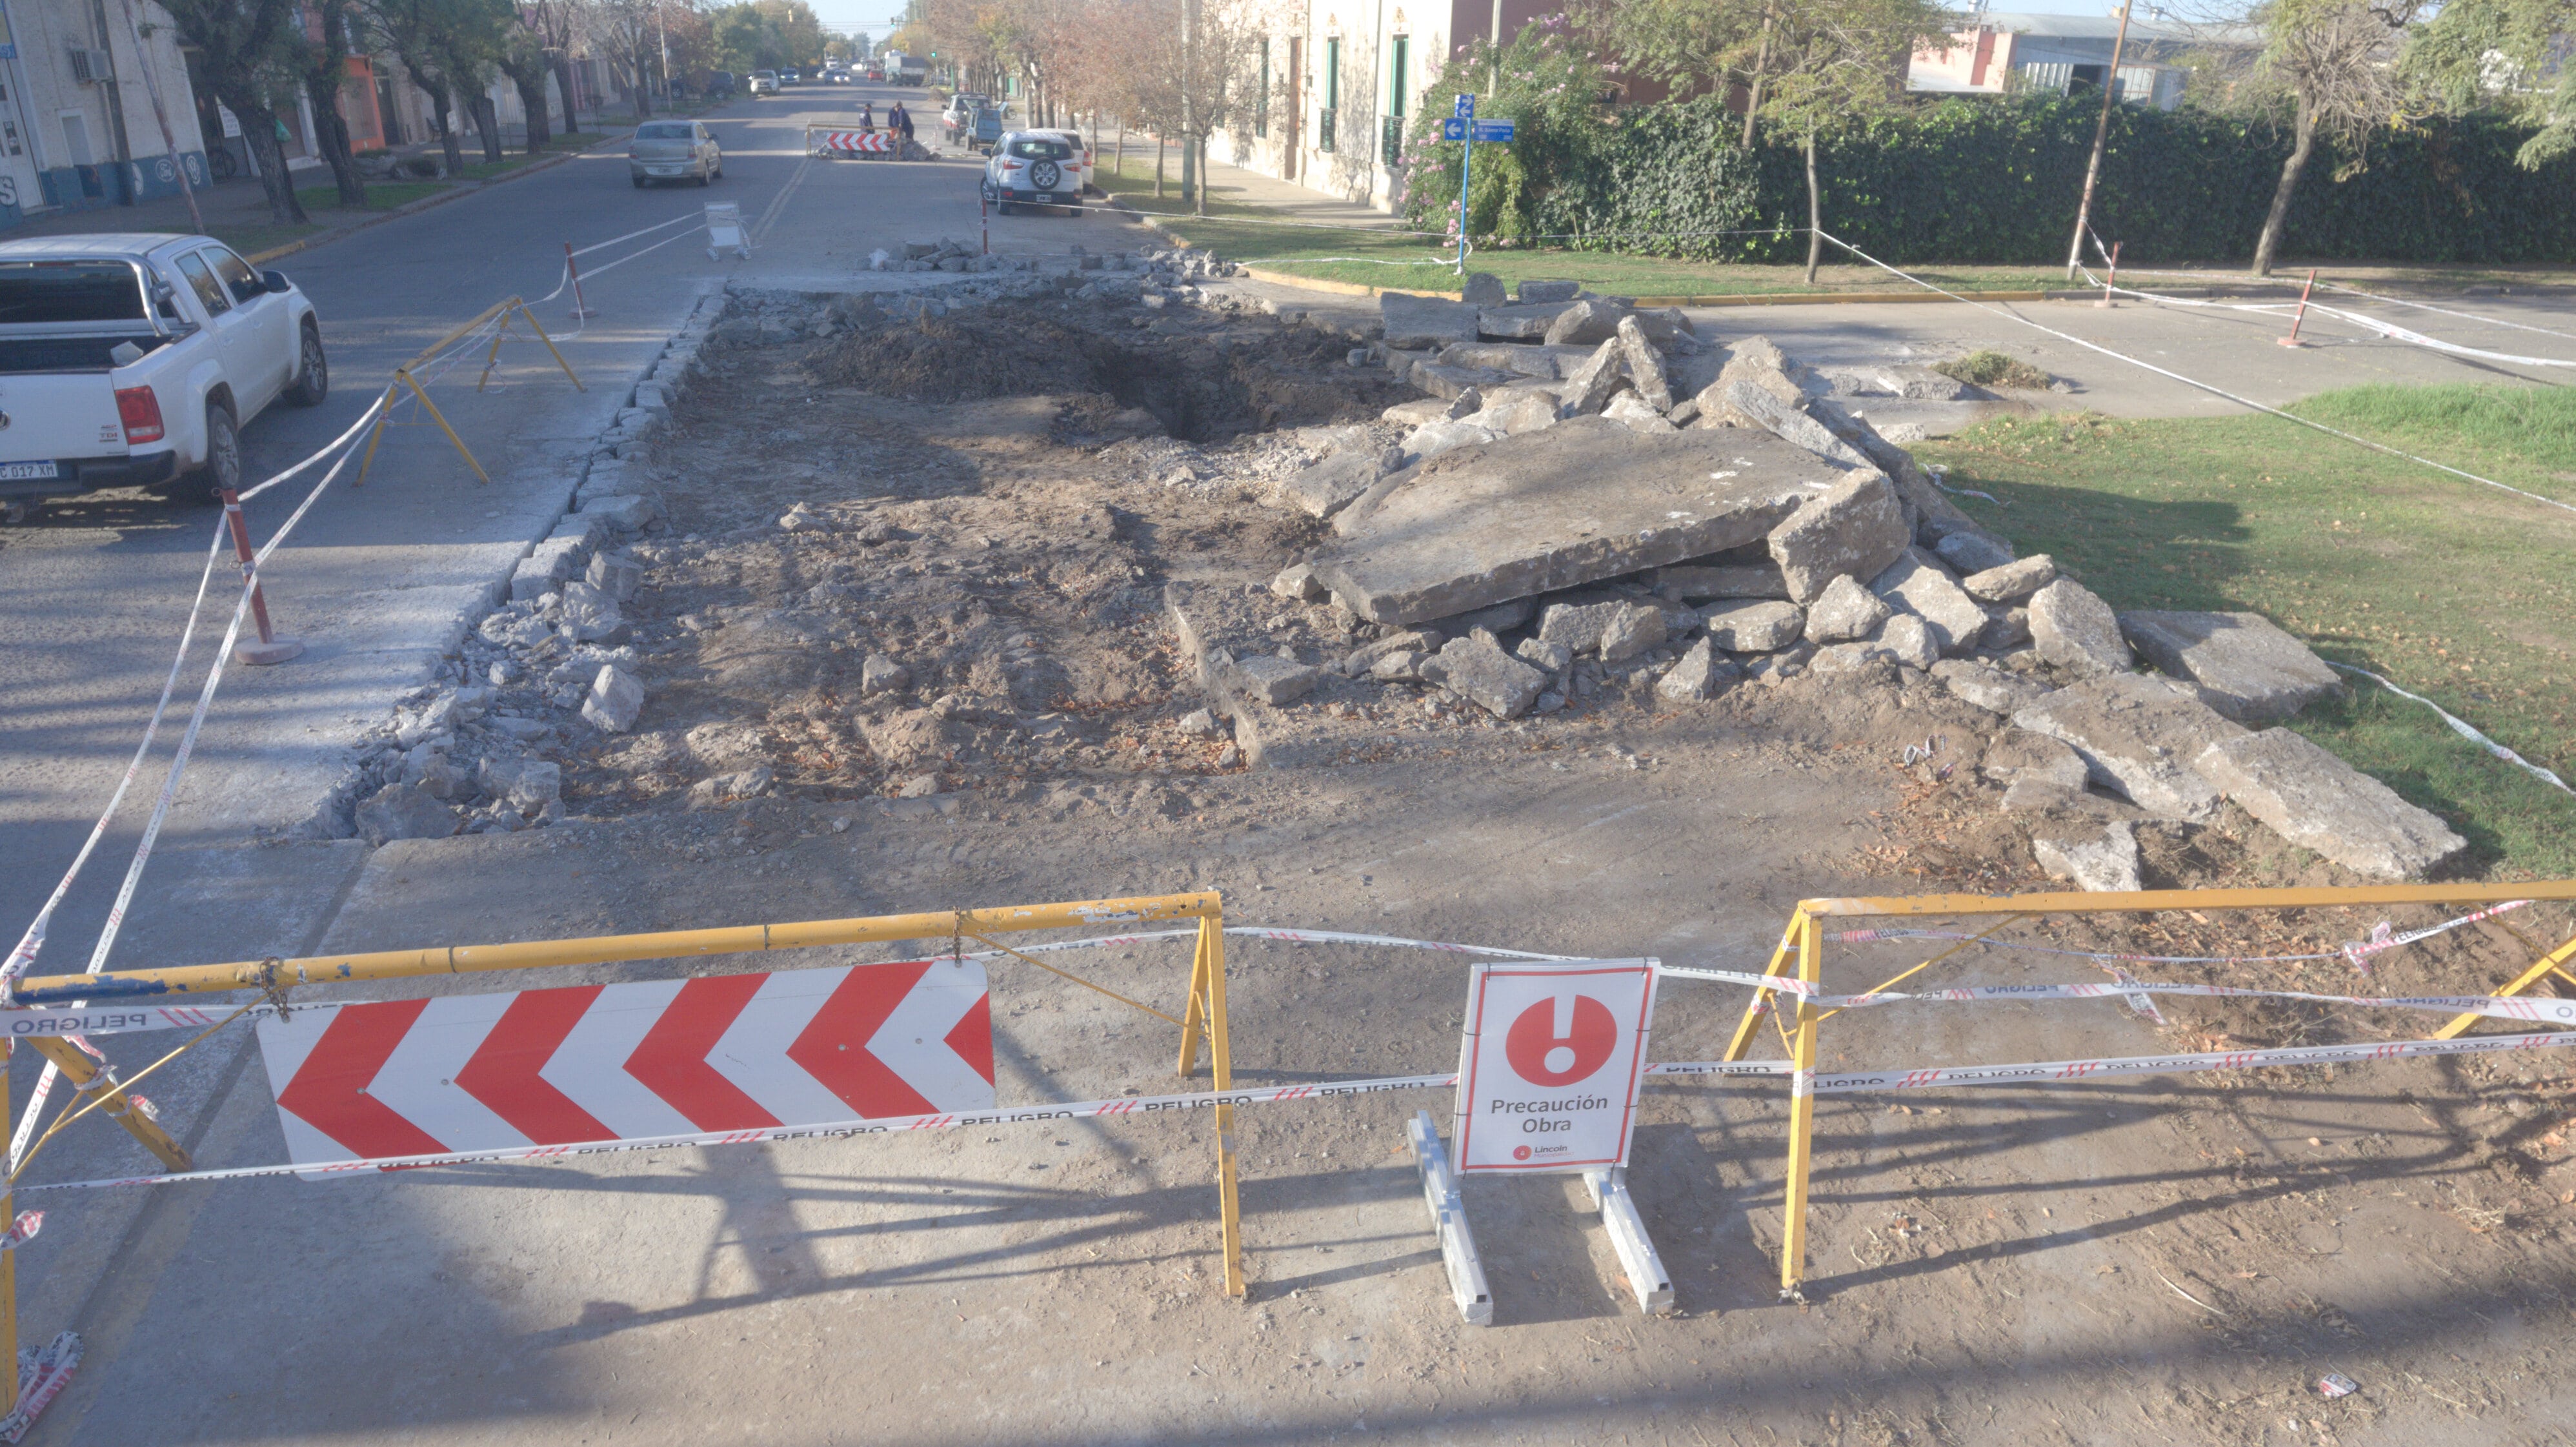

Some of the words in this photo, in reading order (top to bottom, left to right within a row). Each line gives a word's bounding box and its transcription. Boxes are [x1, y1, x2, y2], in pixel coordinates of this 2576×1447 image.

[12, 466, 32, 478] 017
[39, 465, 54, 476] XM
[1491, 1094, 1609, 1114] Precaución
[1522, 1117, 1571, 1133] Obra
[1535, 1145, 1568, 1153] Lincoln
